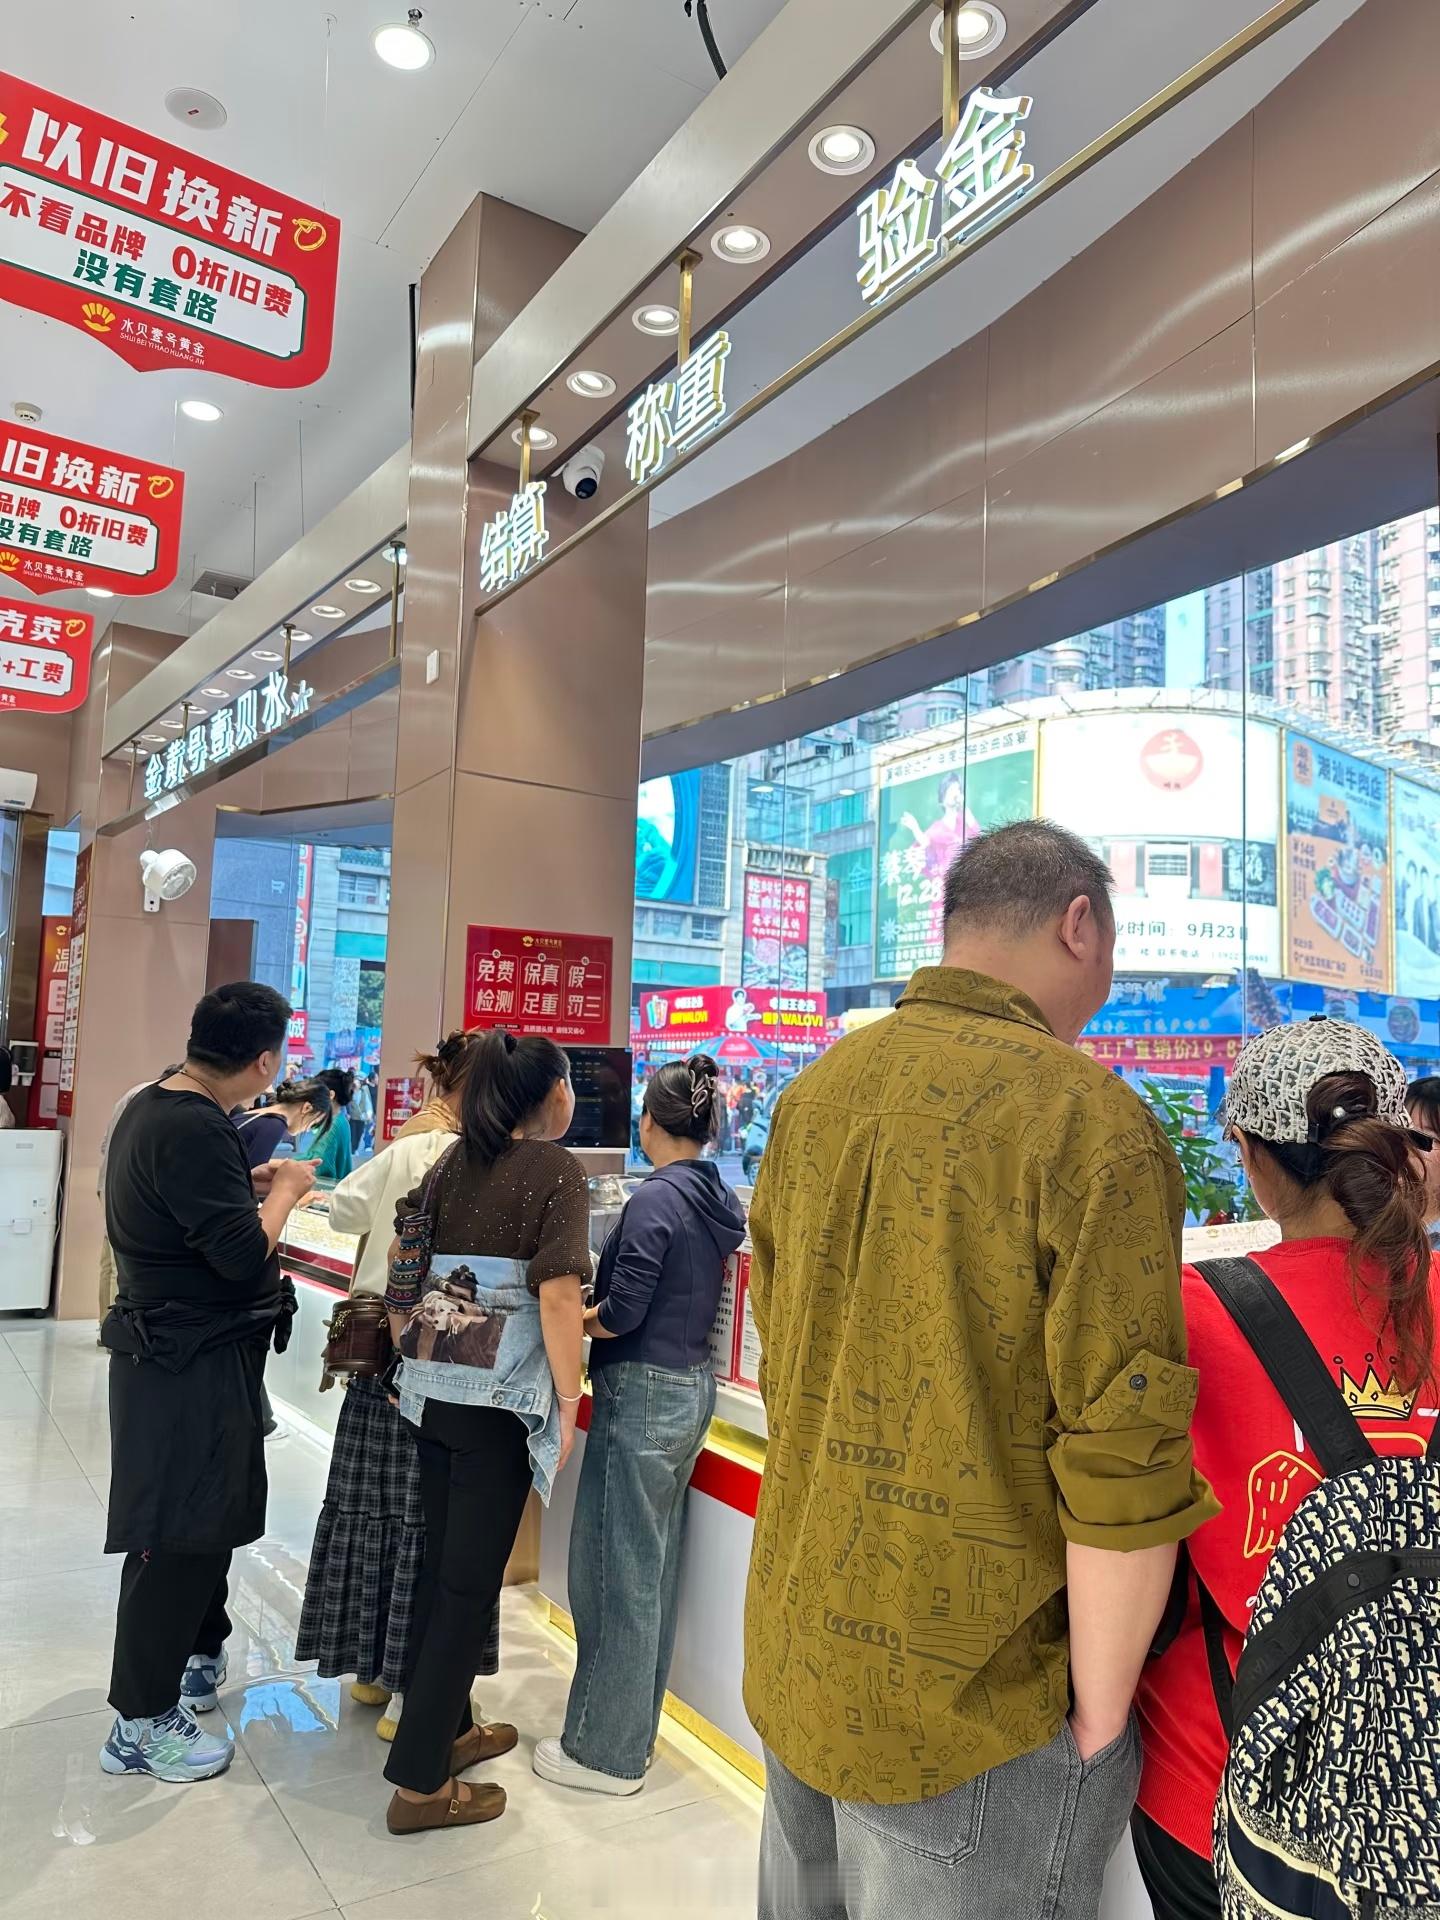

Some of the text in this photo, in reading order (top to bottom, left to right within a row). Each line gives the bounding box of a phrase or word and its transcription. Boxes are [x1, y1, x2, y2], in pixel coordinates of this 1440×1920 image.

[21, 107, 284, 257] 以旧换新
[855, 86, 1035, 305] 验金
[1, 181, 294, 318] 不看品牌 0折旧费
[72, 247, 219, 325] 没有套路
[120, 317, 206, 358] 水贝壹号黄金
[624, 329, 732, 485] 称重
[1, 438, 142, 507] 旧换新
[59, 505, 148, 548] 0折旧费
[479, 480, 550, 593] 结算
[476, 958, 515, 984] 免费
[523, 961, 560, 987] 保真
[568, 965, 603, 989] 假一
[475, 988, 515, 1014] 检测
[521, 991, 559, 1016] 足重
[566, 993, 602, 1018] 罚三
